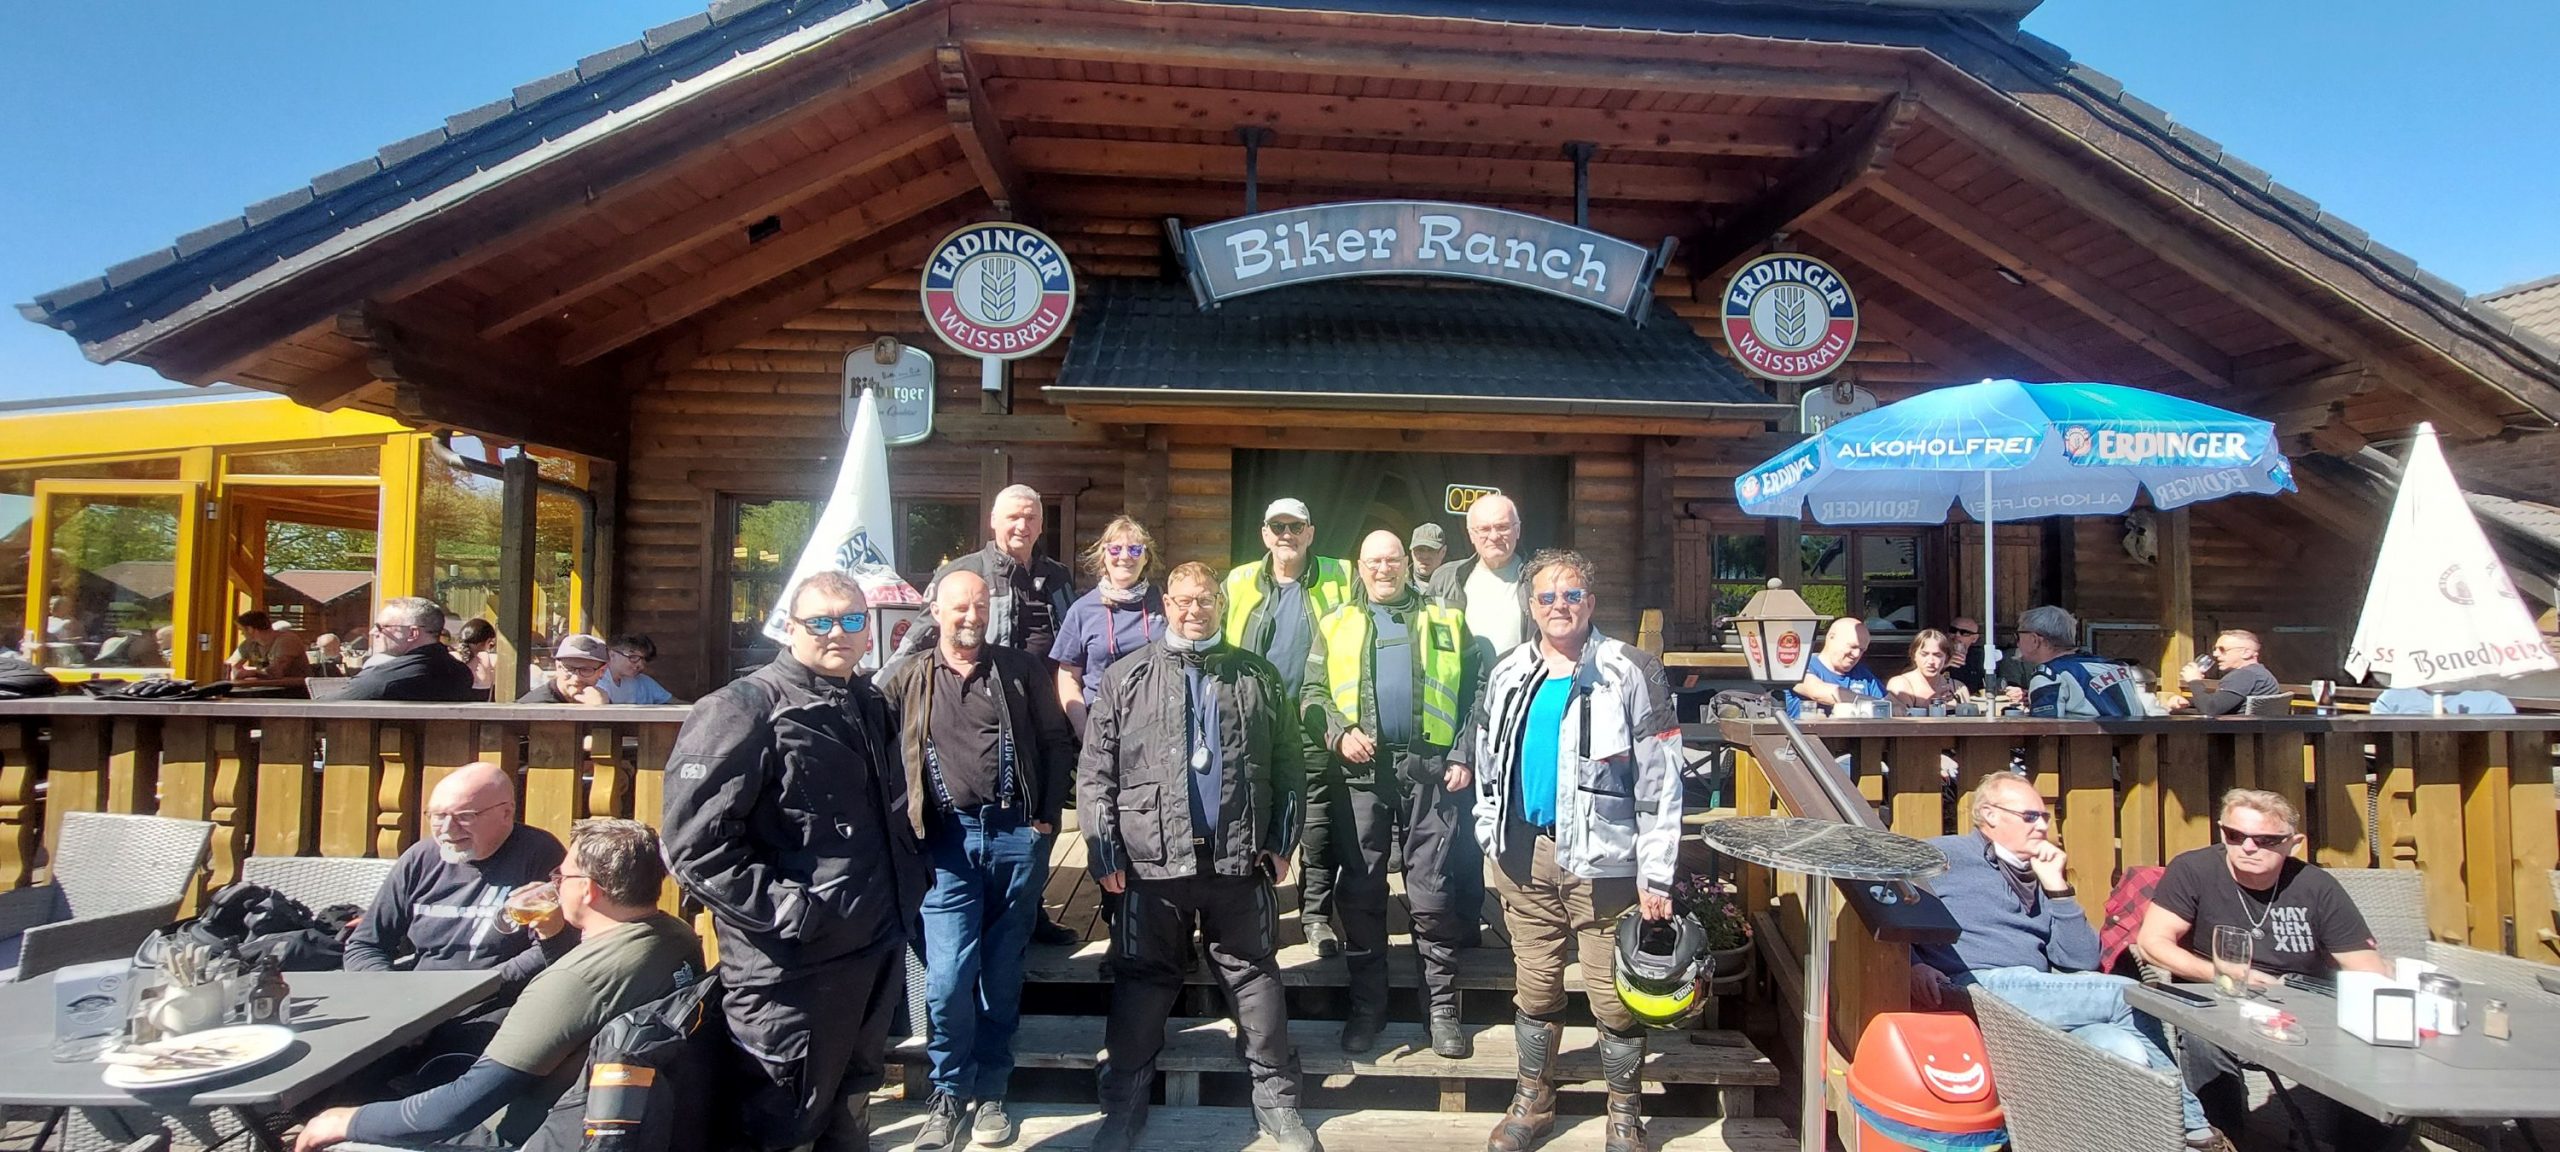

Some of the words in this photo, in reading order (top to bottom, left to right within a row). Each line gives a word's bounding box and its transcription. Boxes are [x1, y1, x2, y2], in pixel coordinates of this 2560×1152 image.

[932, 230, 1061, 283] ERDINGER
[1226, 221, 1396, 281] Biker
[1418, 216, 1608, 293] Ranch
[1731, 261, 1847, 311] ERDINGER
[940, 306, 1059, 350] WEISSBRÄU
[1739, 333, 1845, 372] WEISSBRÄU
[1837, 437, 2033, 458] ALKOHOLFREI
[2099, 430, 2251, 461] ERDINGER
[1449, 488, 1498, 511] OP
[2270, 907, 2308, 922] MAY
[2272, 921, 2312, 936] HEM
[2274, 935, 2315, 953] XIII
